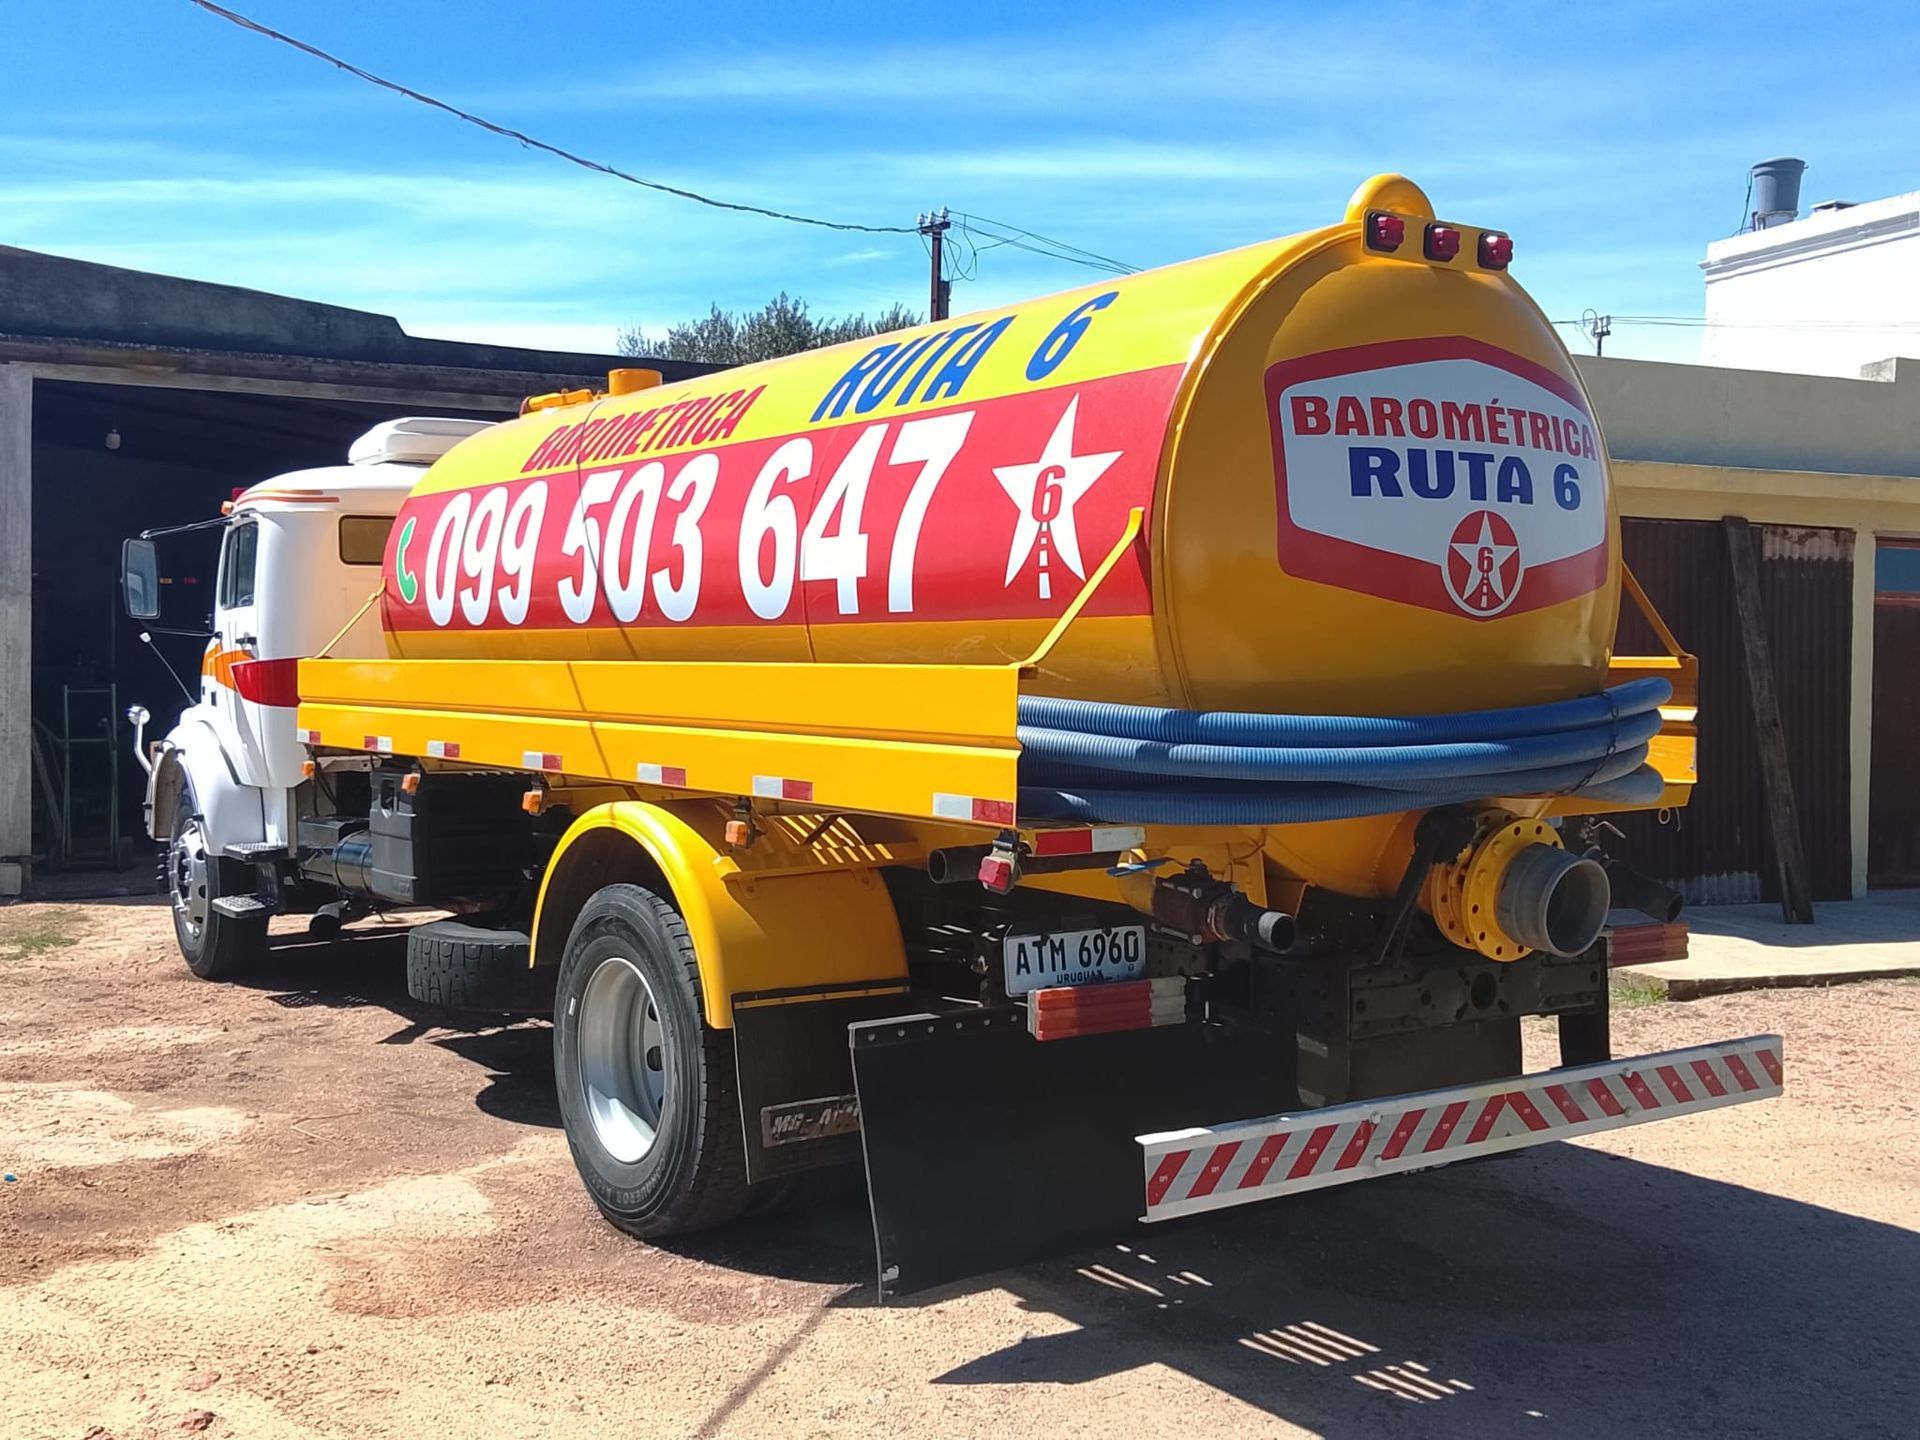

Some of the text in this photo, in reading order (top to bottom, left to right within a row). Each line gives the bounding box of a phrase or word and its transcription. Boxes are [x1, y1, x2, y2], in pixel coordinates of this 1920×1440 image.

[808, 314, 1018, 424] RUTA
[1025, 291, 1120, 382] 6
[1290, 395, 1597, 461] BAROMÉTRICA
[1031, 464, 1066, 523] 6
[1348, 446, 1582, 511] RUTA 6
[424, 410, 976, 627] 099 503 647
[1477, 545, 1494, 574] 6
[1016, 930, 1139, 976] ATM 6960
